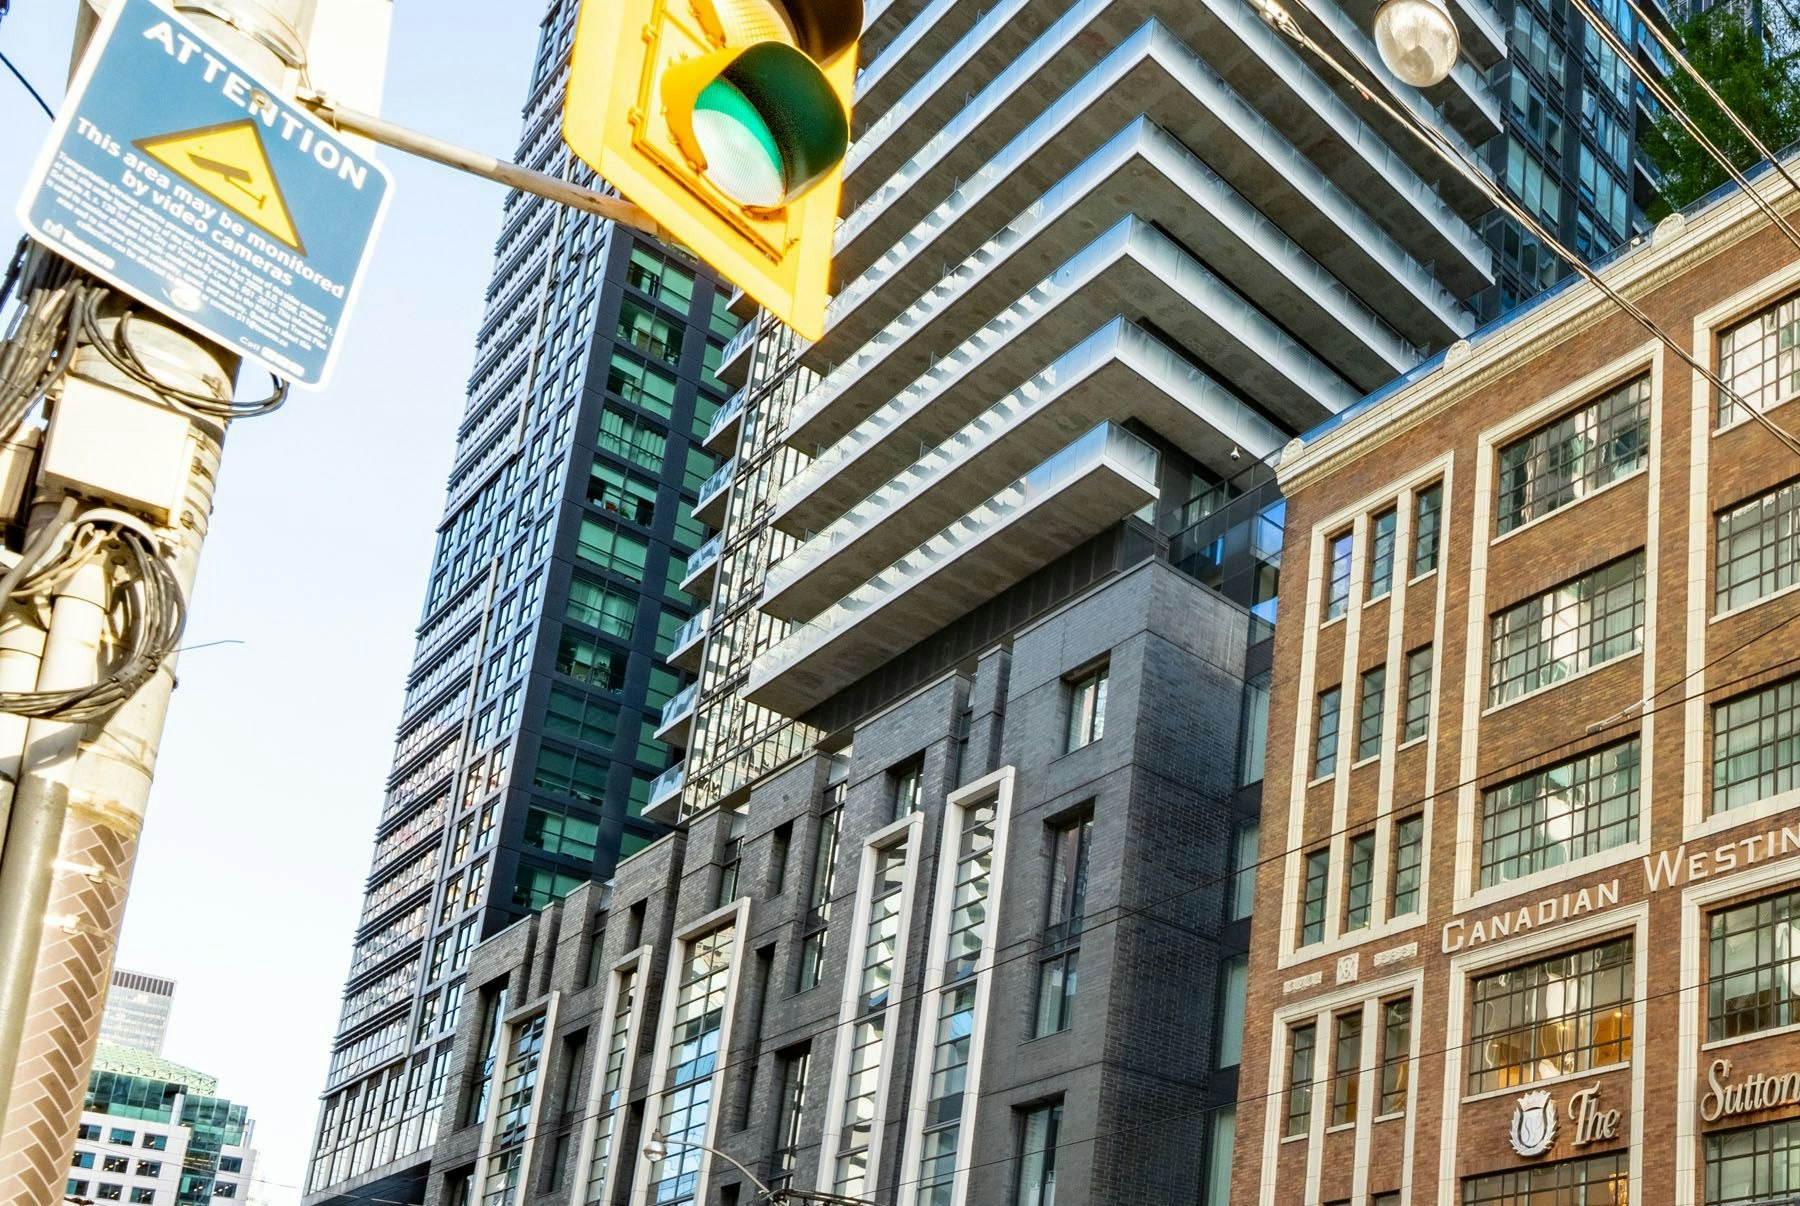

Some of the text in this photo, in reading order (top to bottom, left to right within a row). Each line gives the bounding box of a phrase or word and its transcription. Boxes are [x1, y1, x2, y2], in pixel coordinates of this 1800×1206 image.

[143, 21, 368, 190] ATTENTION
[77, 118, 122, 157] This
[123, 150, 171, 189] area
[173, 183, 217, 223] may
[219, 205, 245, 236] be
[247, 229, 345, 300] monitored
[121, 170, 293, 287] by video cameras
[1442, 879, 1619, 953] CANADIAN
[1567, 1081, 1621, 1146] The
